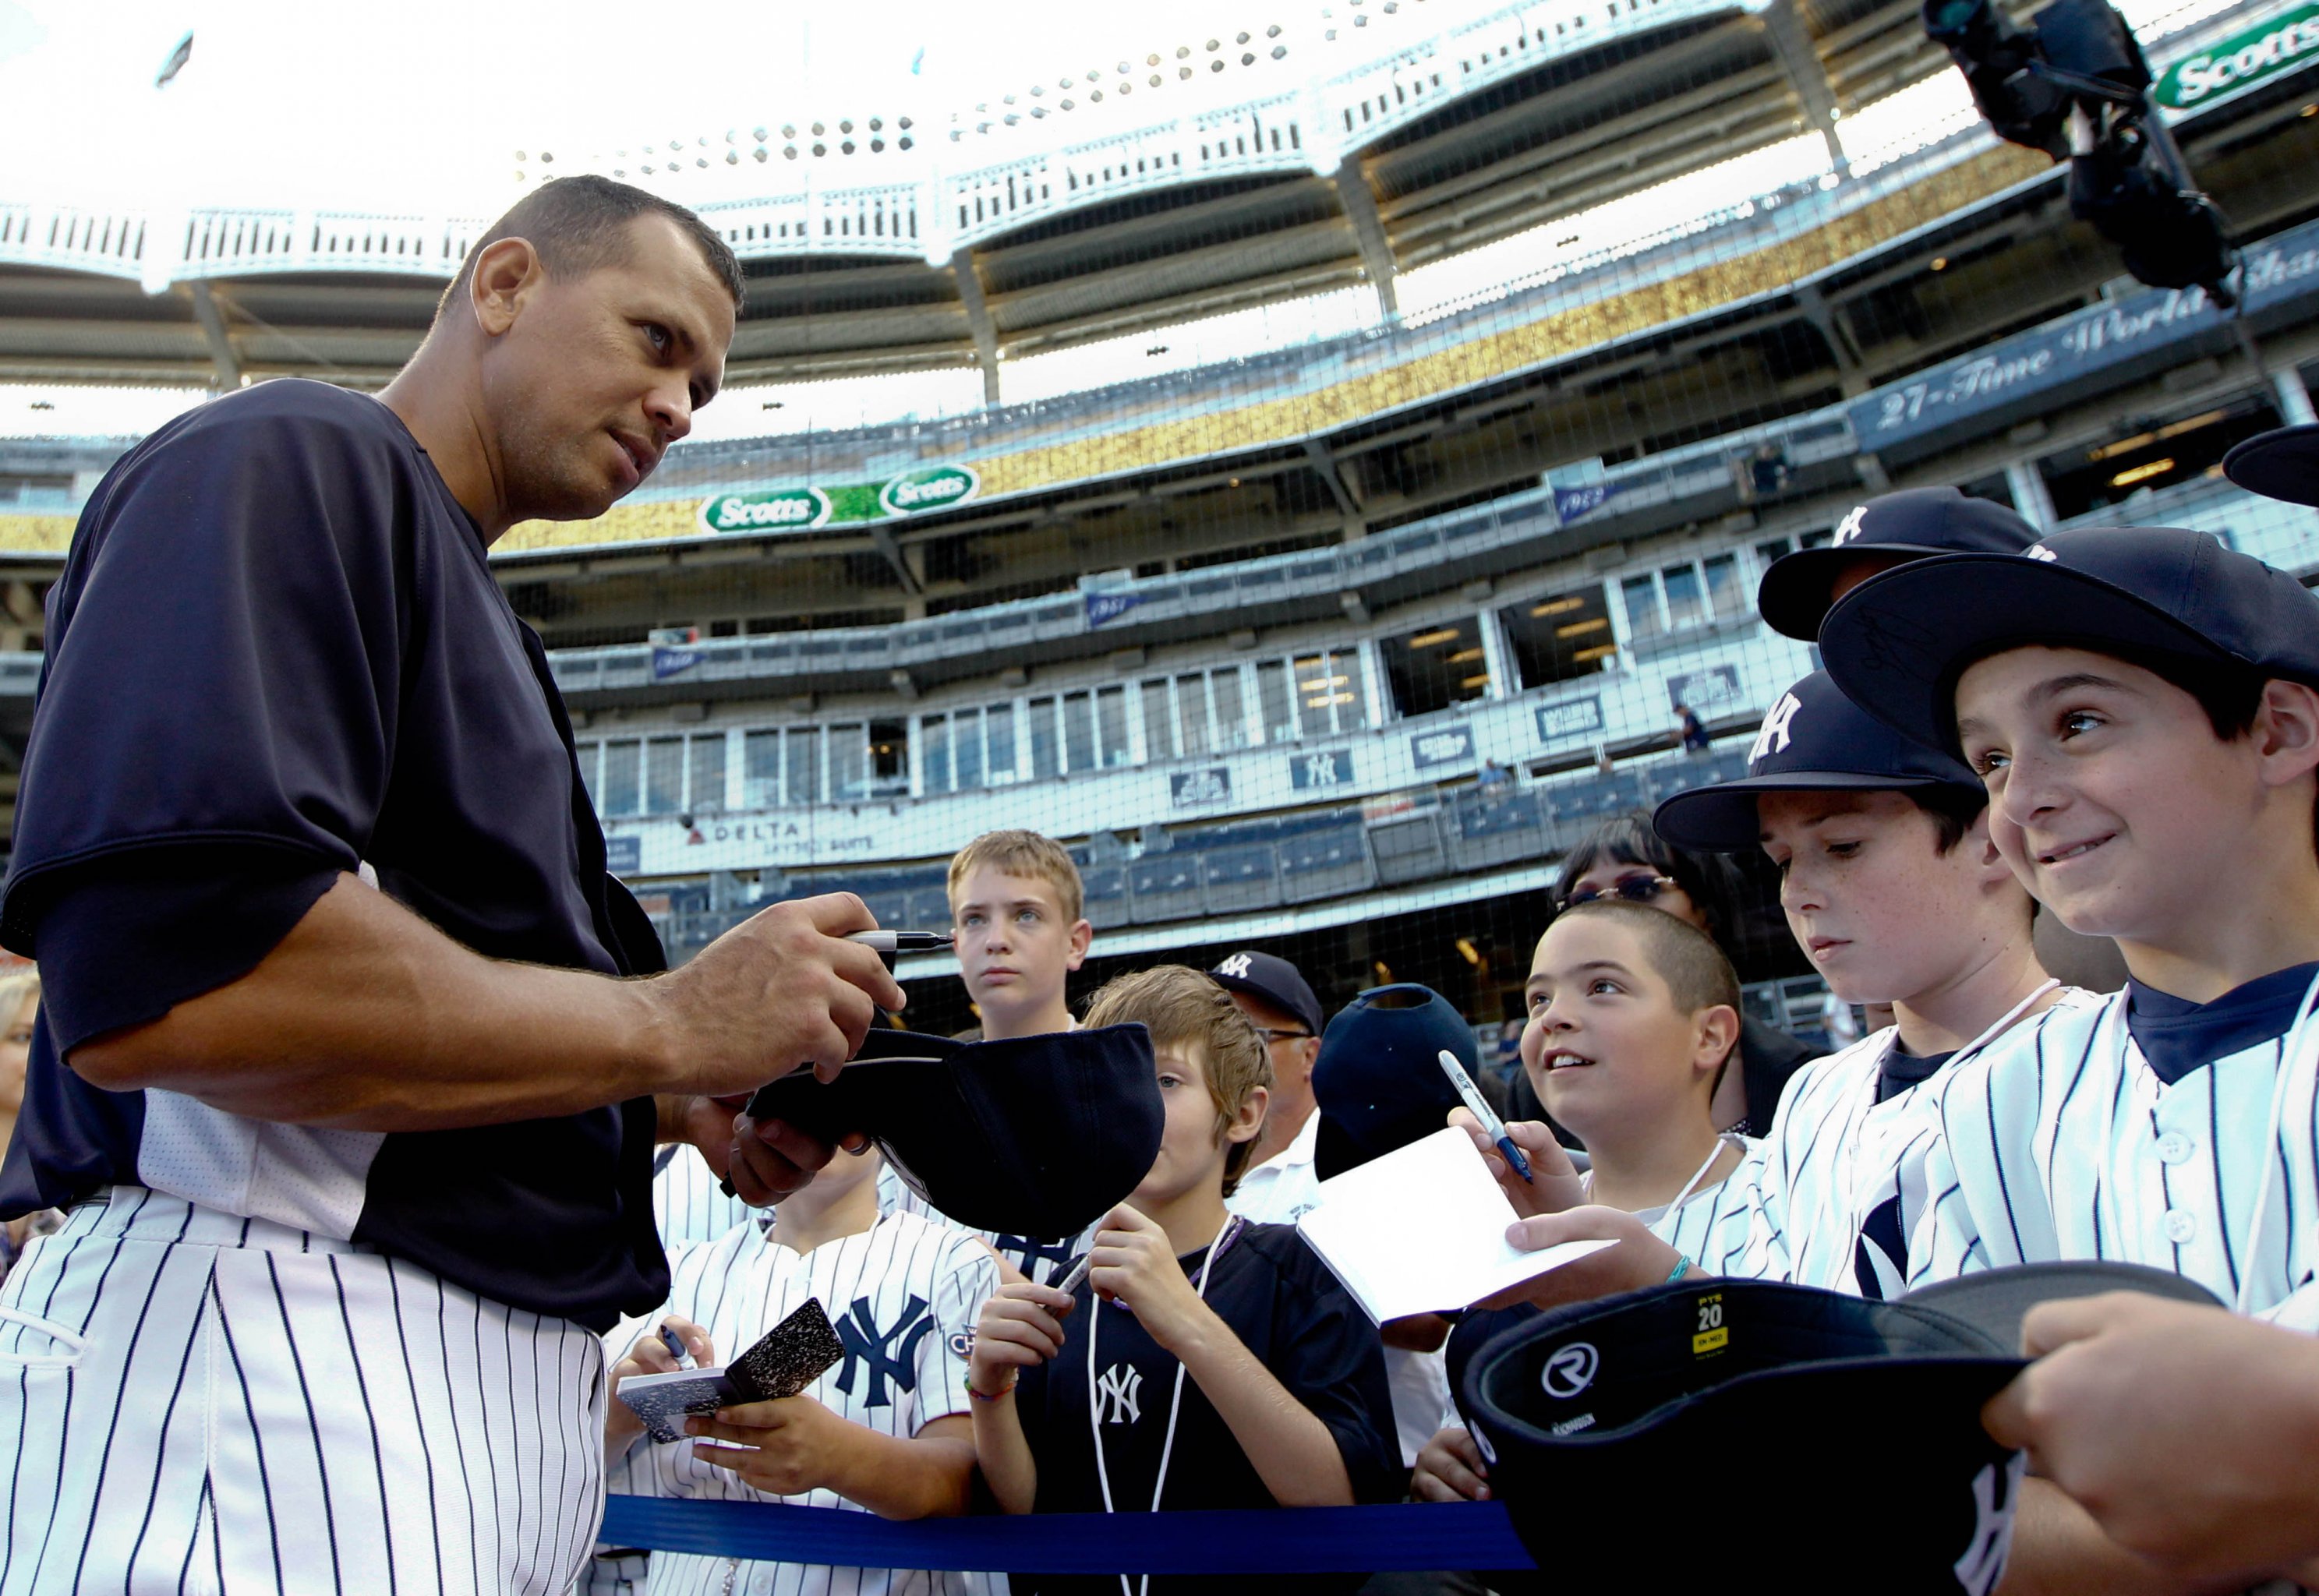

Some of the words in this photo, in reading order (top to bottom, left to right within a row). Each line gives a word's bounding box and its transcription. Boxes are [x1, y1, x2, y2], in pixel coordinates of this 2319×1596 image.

[895, 475, 967, 507] Scotts
[716, 497, 813, 528] Scotts
[715, 822, 799, 841] DELTA
[1698, 1303, 1722, 1332] 20
[834, 1293, 934, 1408] NY
[1096, 1363, 1143, 1425] NY
